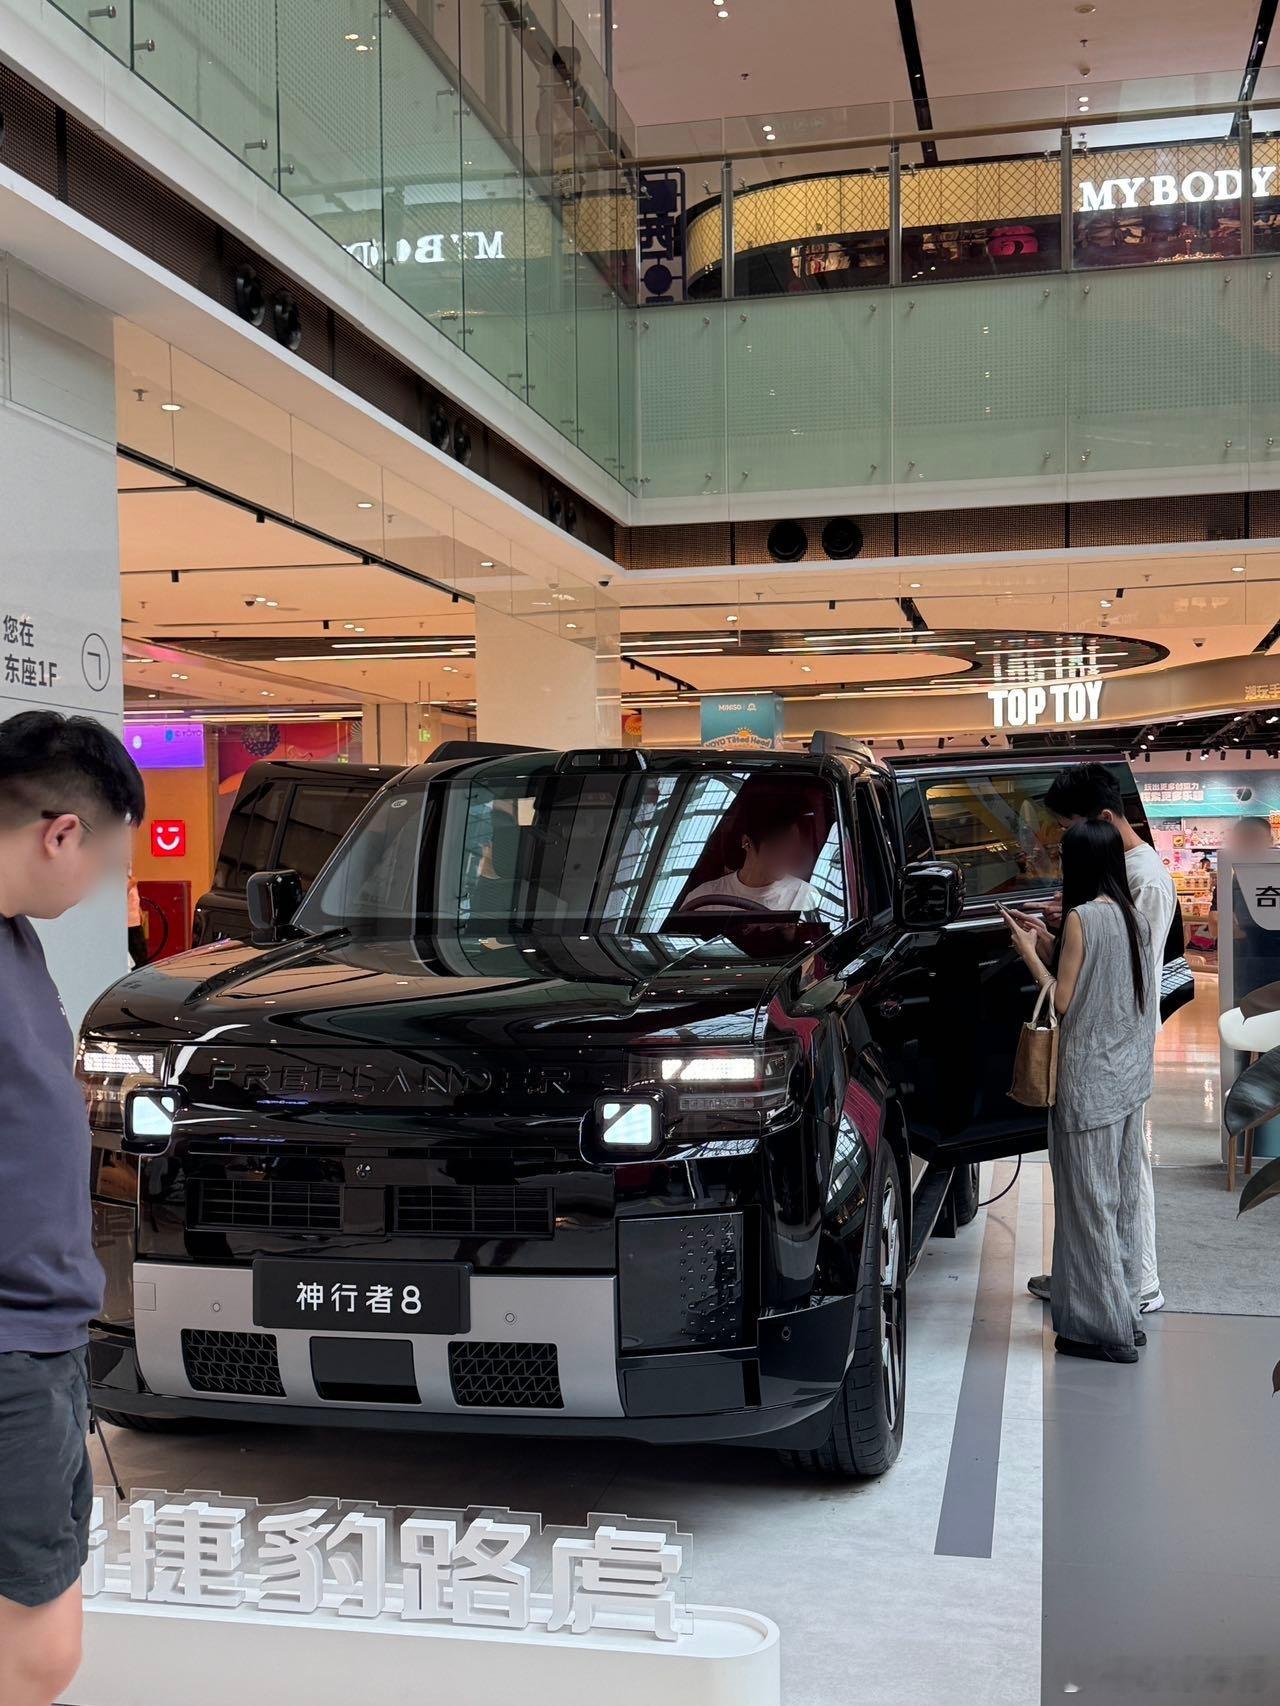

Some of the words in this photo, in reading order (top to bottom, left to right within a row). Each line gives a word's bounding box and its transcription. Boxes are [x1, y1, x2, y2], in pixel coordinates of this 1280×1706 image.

[3, 614, 34, 648] 您在
[4, 653, 58, 688] 东座1F
[987, 687, 1047, 728] TOP
[1050, 680, 1103, 723] TOY
[208, 1063, 572, 1097] FREELANDR
[296, 1281, 422, 1316] 神行者8
[82, 1496, 685, 1641] 捷豹路虎
